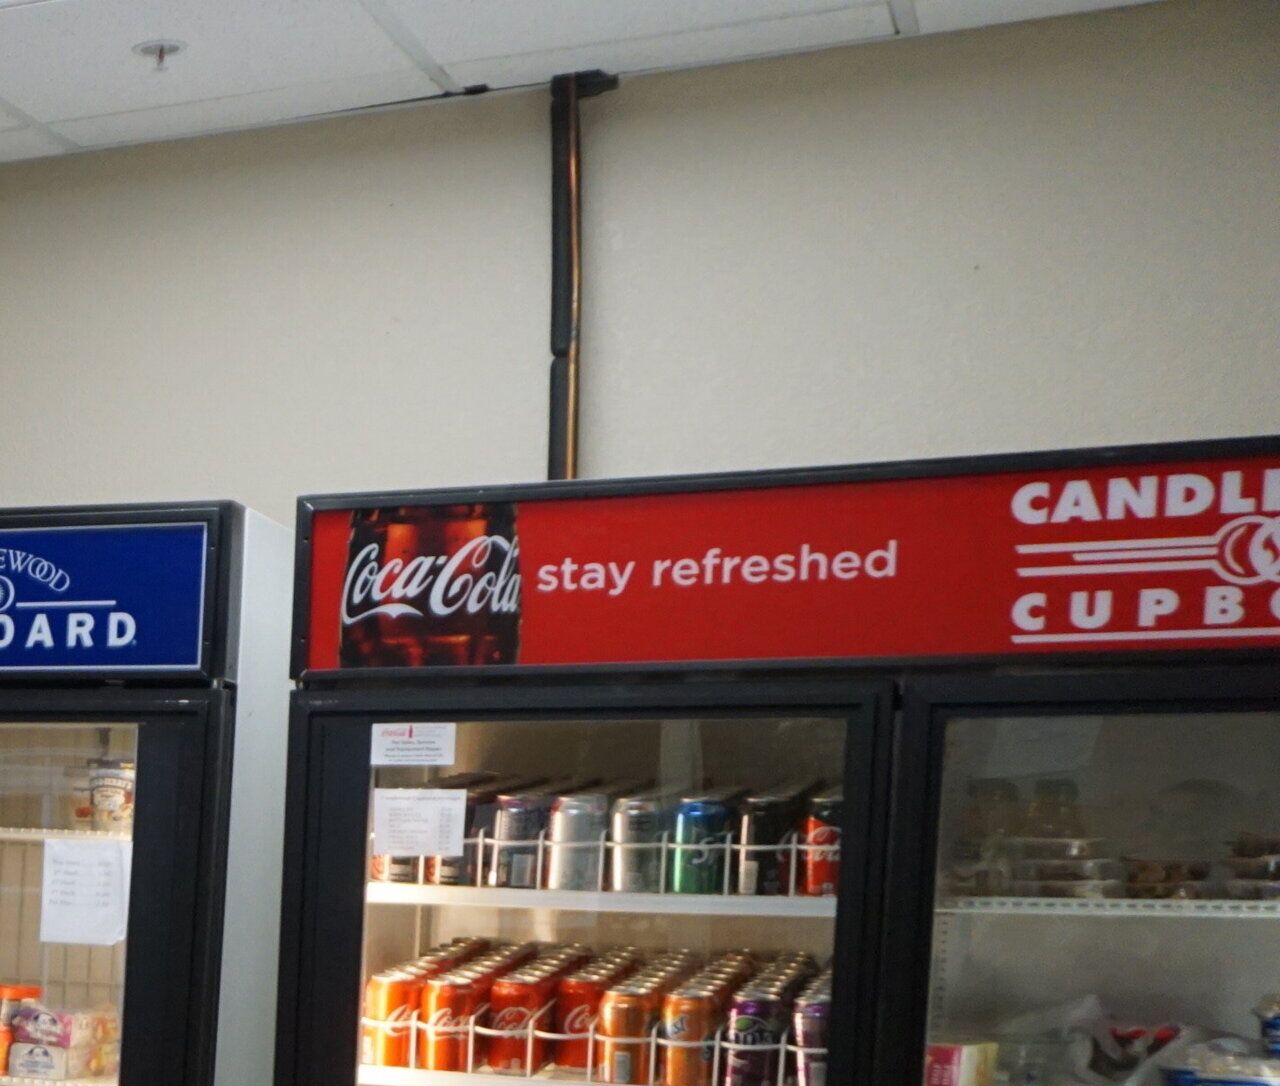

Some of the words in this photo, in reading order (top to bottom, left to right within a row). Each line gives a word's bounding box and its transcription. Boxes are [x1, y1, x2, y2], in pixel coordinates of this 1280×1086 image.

[342, 535, 521, 625] Coca-Cola
[537, 556, 636, 597] stay
[652, 540, 899, 587] refreshed
[1010, 585, 1280, 631] CUPB
